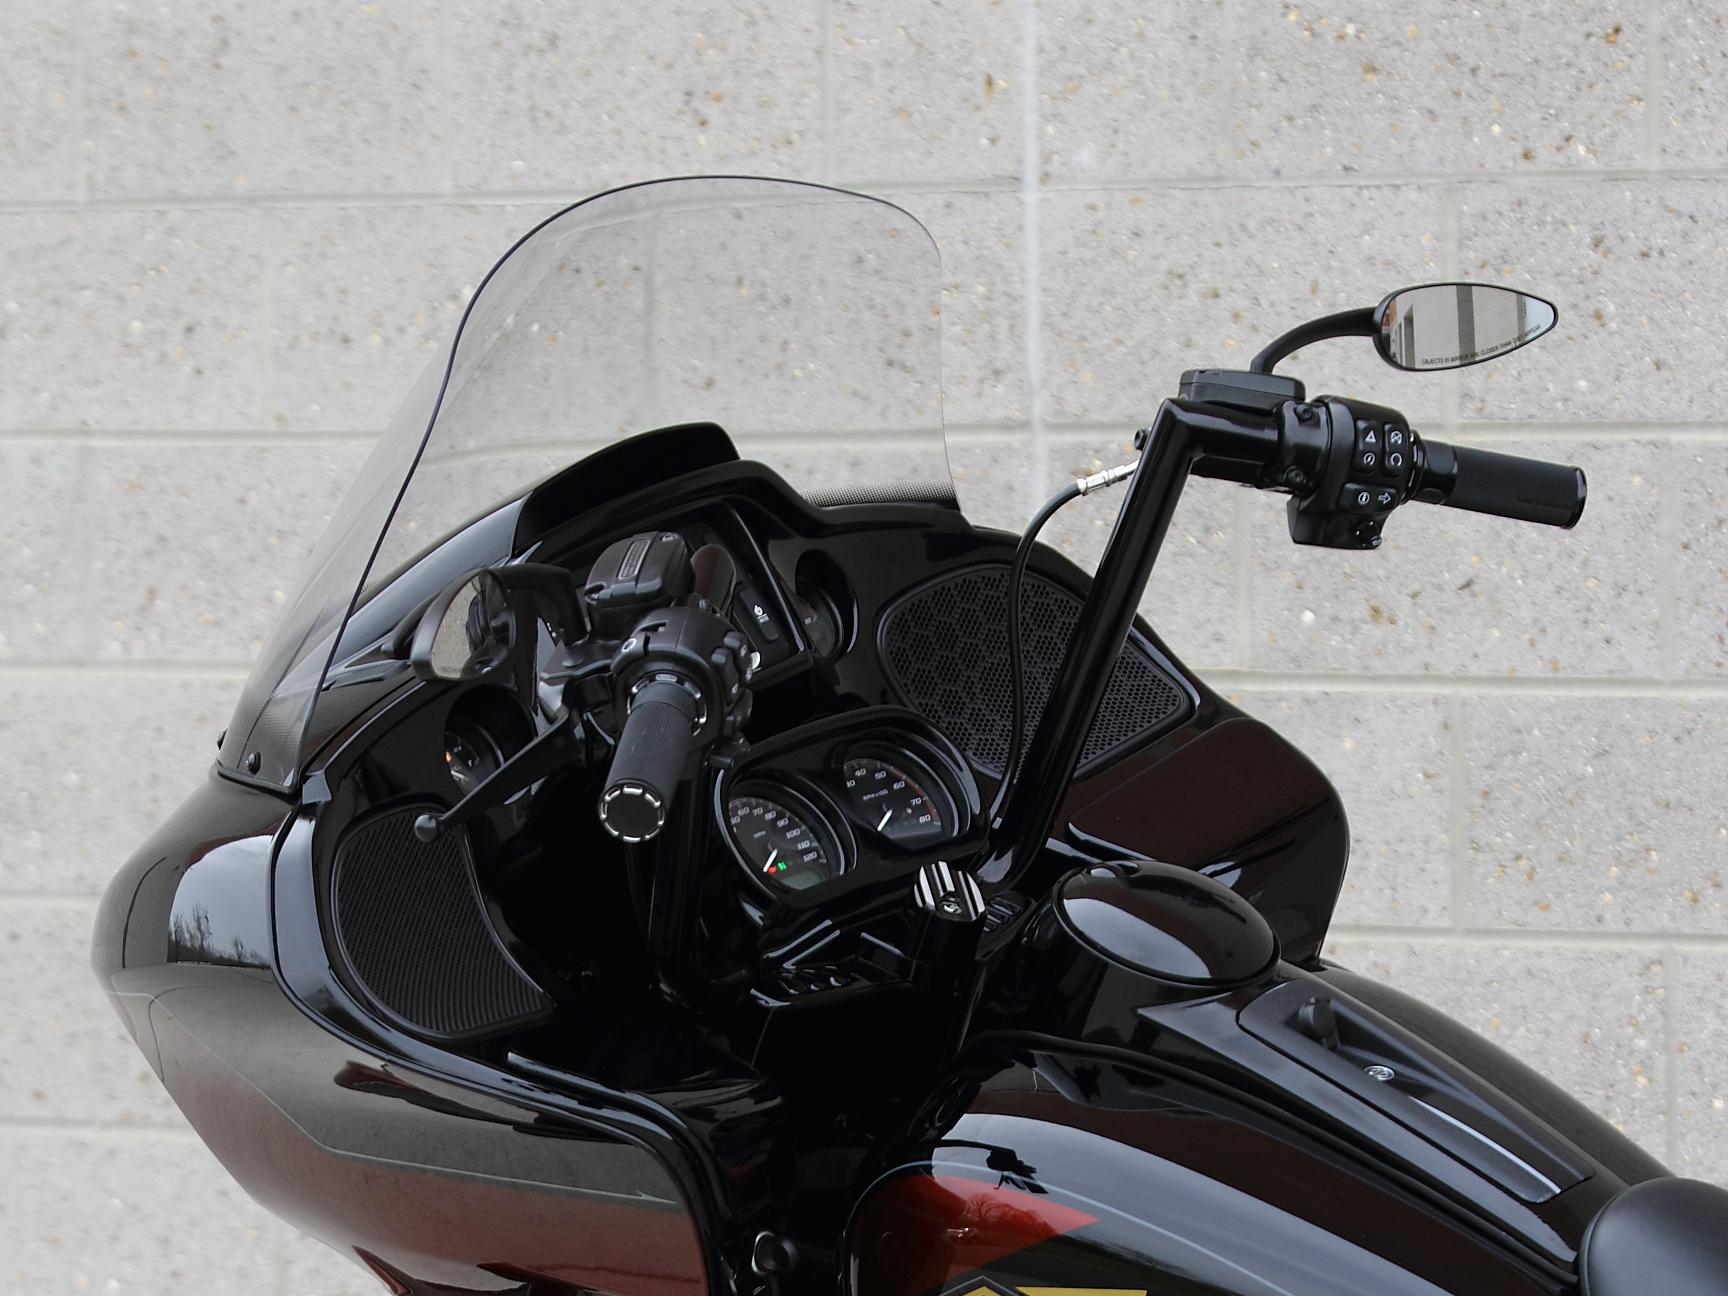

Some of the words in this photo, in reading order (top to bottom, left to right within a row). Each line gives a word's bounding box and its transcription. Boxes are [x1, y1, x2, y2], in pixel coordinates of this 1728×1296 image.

[1422, 357, 1444, 365] OBJECTS
[1450, 354, 1469, 363] MIRROR
[1470, 350, 1480, 358] ARE
[1481, 345, 1499, 356] CLOSER
[1524, 323, 1541, 338] APPEAR
[854, 768, 867, 777] 40
[874, 770, 887, 779] 50
[893, 780, 905, 790] 60
[910, 797, 922, 806] 70
[738, 806, 750, 816] 60
[752, 807, 764, 816] 70
[764, 810, 776, 820] 80
[776, 817, 789, 827] 90
[918, 814, 931, 824] 80
[786, 828, 801, 838] 100
[797, 840, 810, 850] 110
[803, 851, 817, 862] 120
